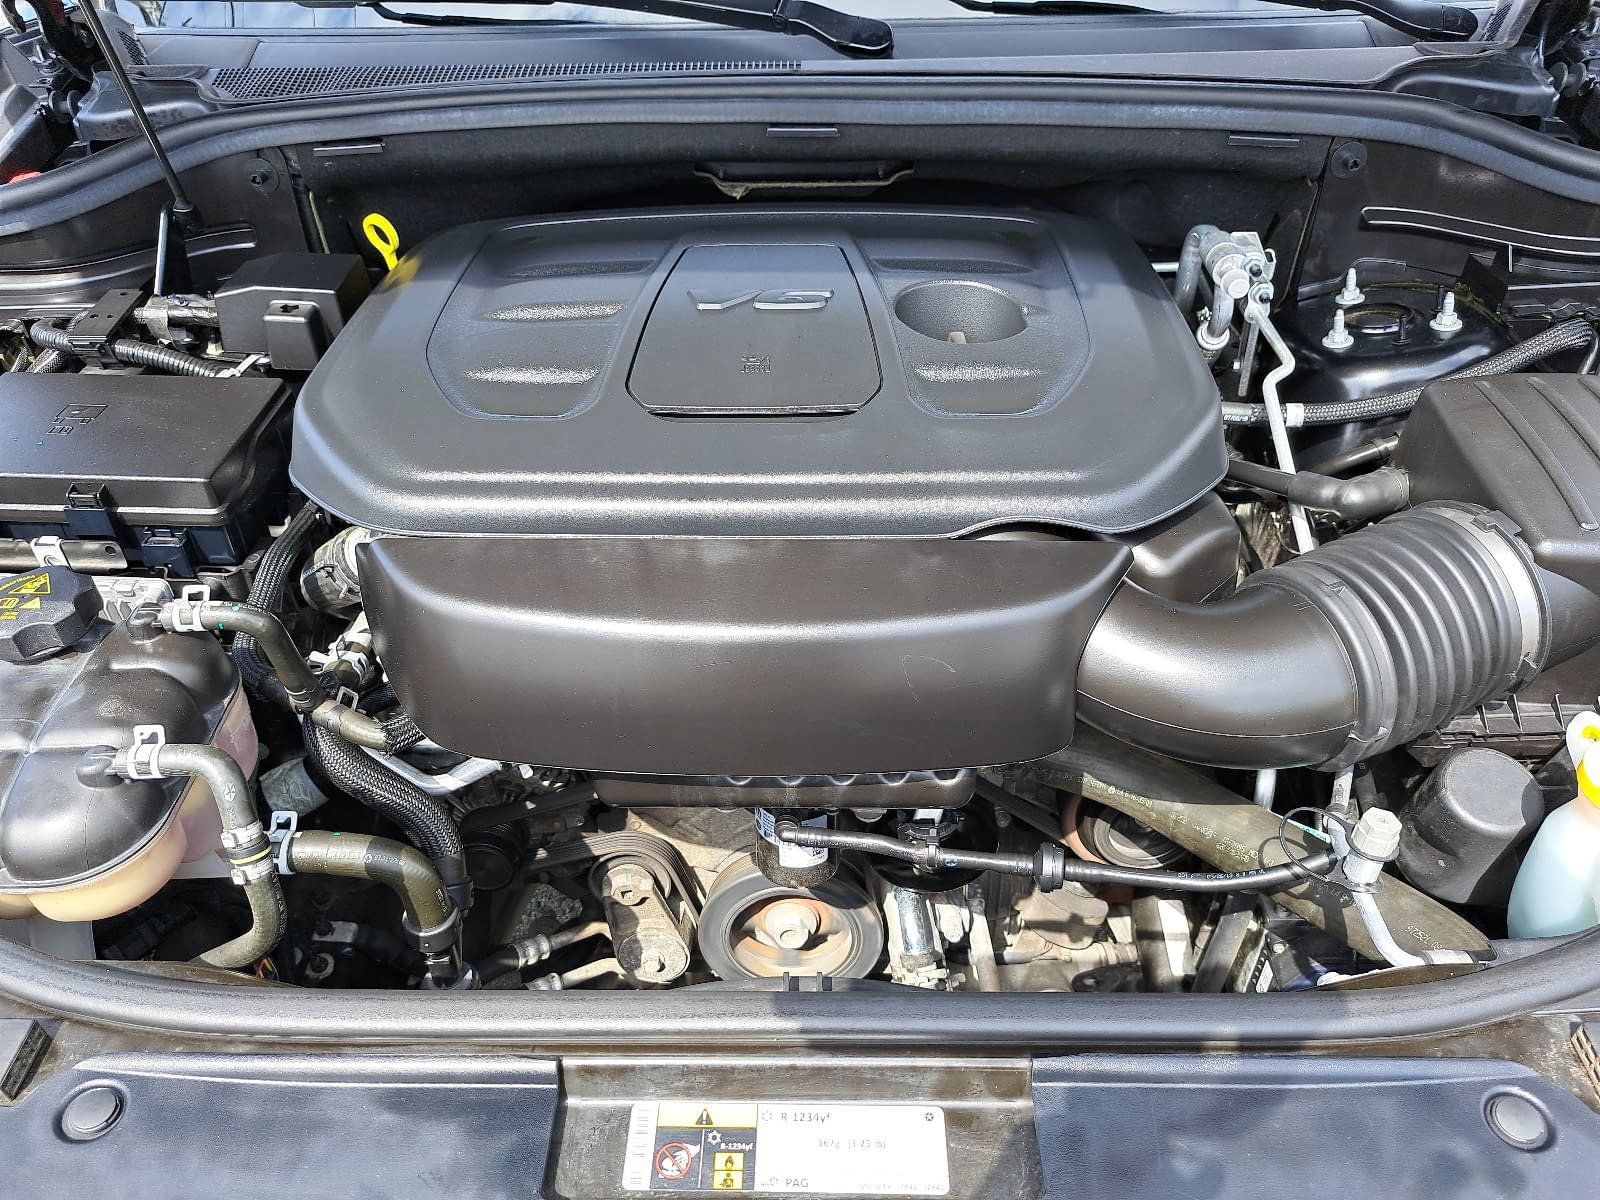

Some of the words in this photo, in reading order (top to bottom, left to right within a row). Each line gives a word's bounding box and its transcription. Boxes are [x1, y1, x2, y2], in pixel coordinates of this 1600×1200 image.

[687, 288, 834, 310] V6
[781, 1112, 788, 1121] R
[786, 1178, 809, 1188] PAG
